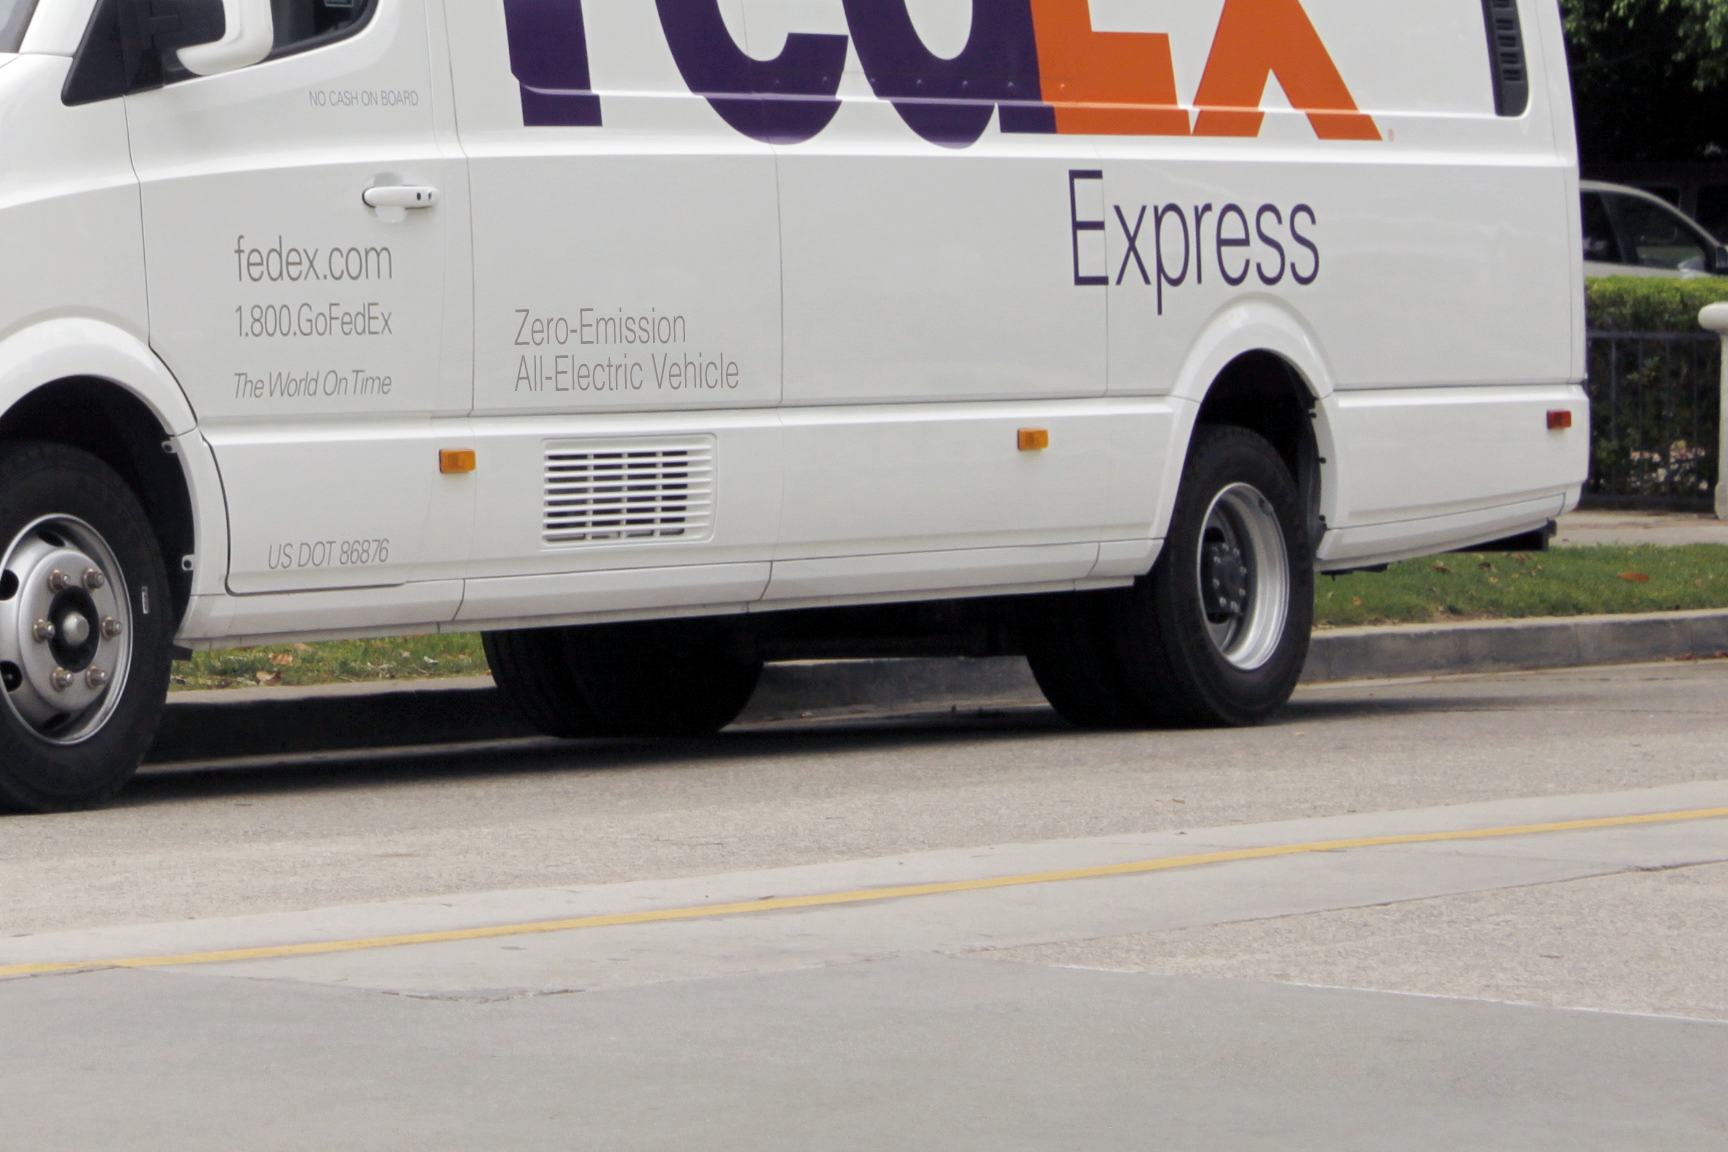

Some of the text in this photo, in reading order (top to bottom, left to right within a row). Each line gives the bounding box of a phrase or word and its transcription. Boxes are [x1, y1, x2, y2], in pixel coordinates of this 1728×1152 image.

[308, 90, 419, 107] NO CASH ON BOARD
[233, 234, 393, 282] fedex.com
[1068, 169, 1320, 315] Express
[234, 302, 393, 338] 1.800.GoFedEx
[514, 307, 686, 346] Zero-Emission
[234, 369, 392, 399] The World On Time
[514, 351, 739, 392] All-Electric Vehicle
[268, 538, 390, 569] US DOT 86876
